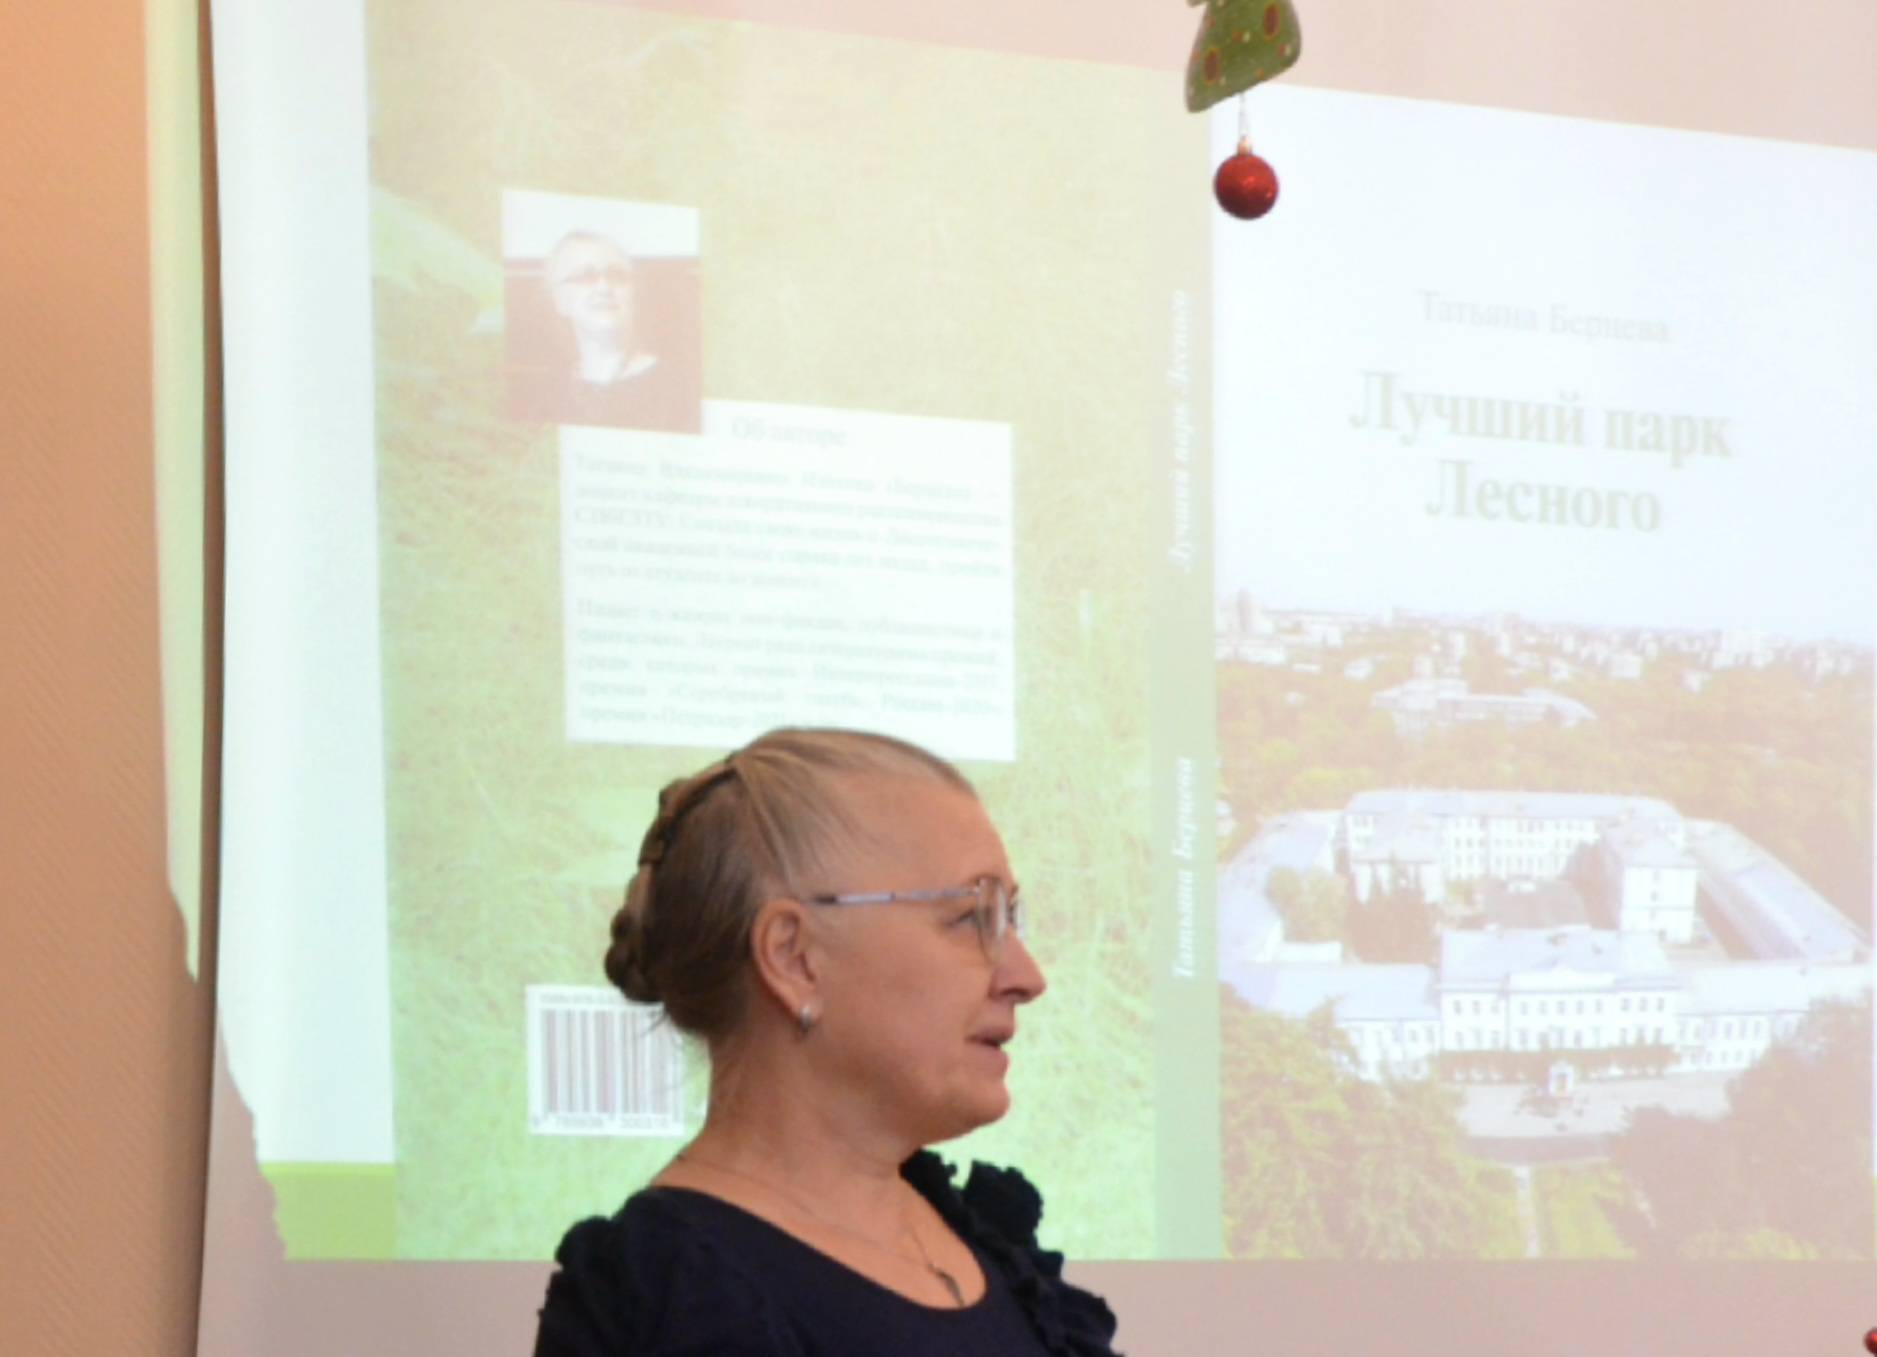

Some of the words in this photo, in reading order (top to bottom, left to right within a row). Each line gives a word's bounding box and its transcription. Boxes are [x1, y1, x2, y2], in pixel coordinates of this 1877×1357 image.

[1415, 288, 1539, 332] Татьяна
[1348, 369, 1586, 448] Лучший
[1603, 406, 1734, 471] парк
[1423, 457, 1662, 533] Лесного
